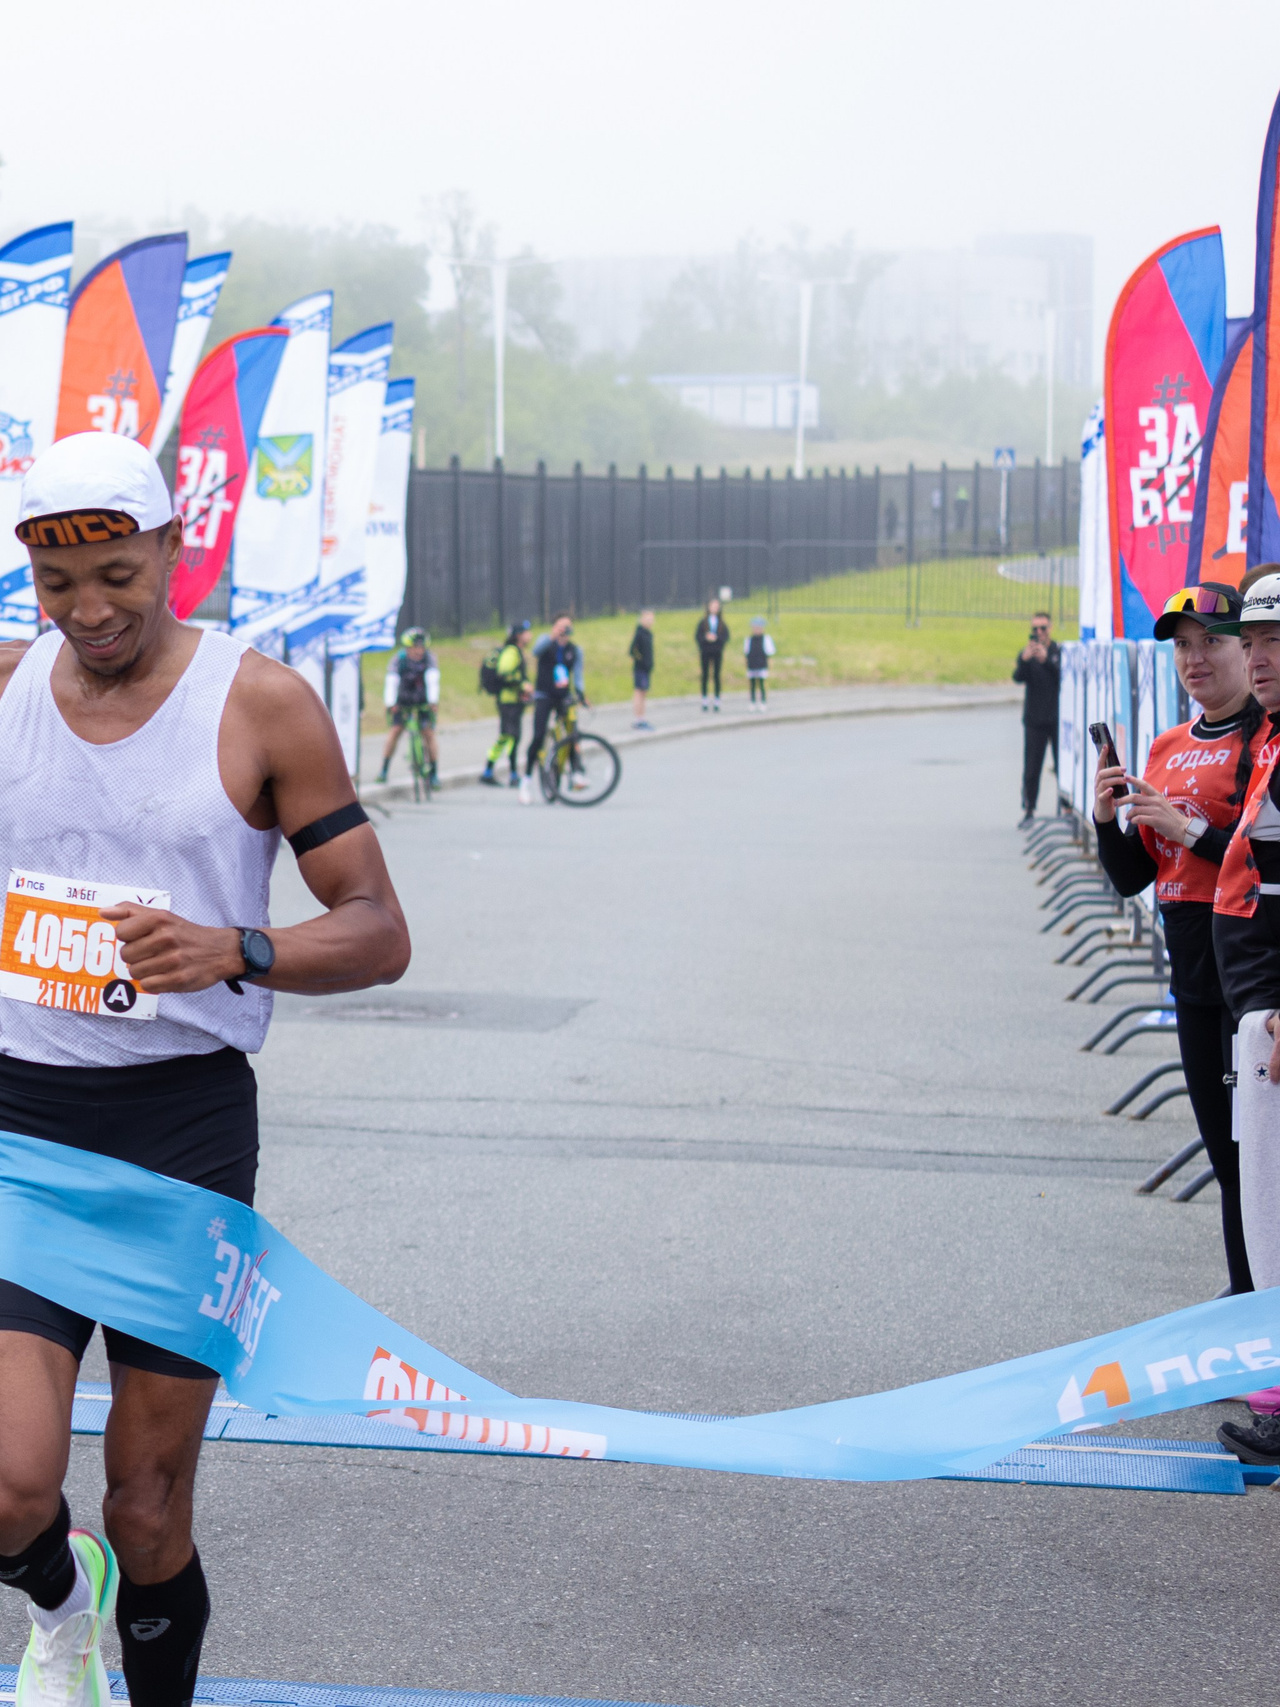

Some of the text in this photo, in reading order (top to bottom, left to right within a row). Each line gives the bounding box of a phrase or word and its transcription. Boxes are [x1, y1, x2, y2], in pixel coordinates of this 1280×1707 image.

[1138, 403, 1204, 469] ЗА
[179, 446, 228, 499] ЗА
[1129, 464, 1202, 528] БЕ
[174, 495, 234, 549] ЕГ
[1166, 750, 1231, 771] СУДЬЯ
[26, 880, 45, 891] ПСБ
